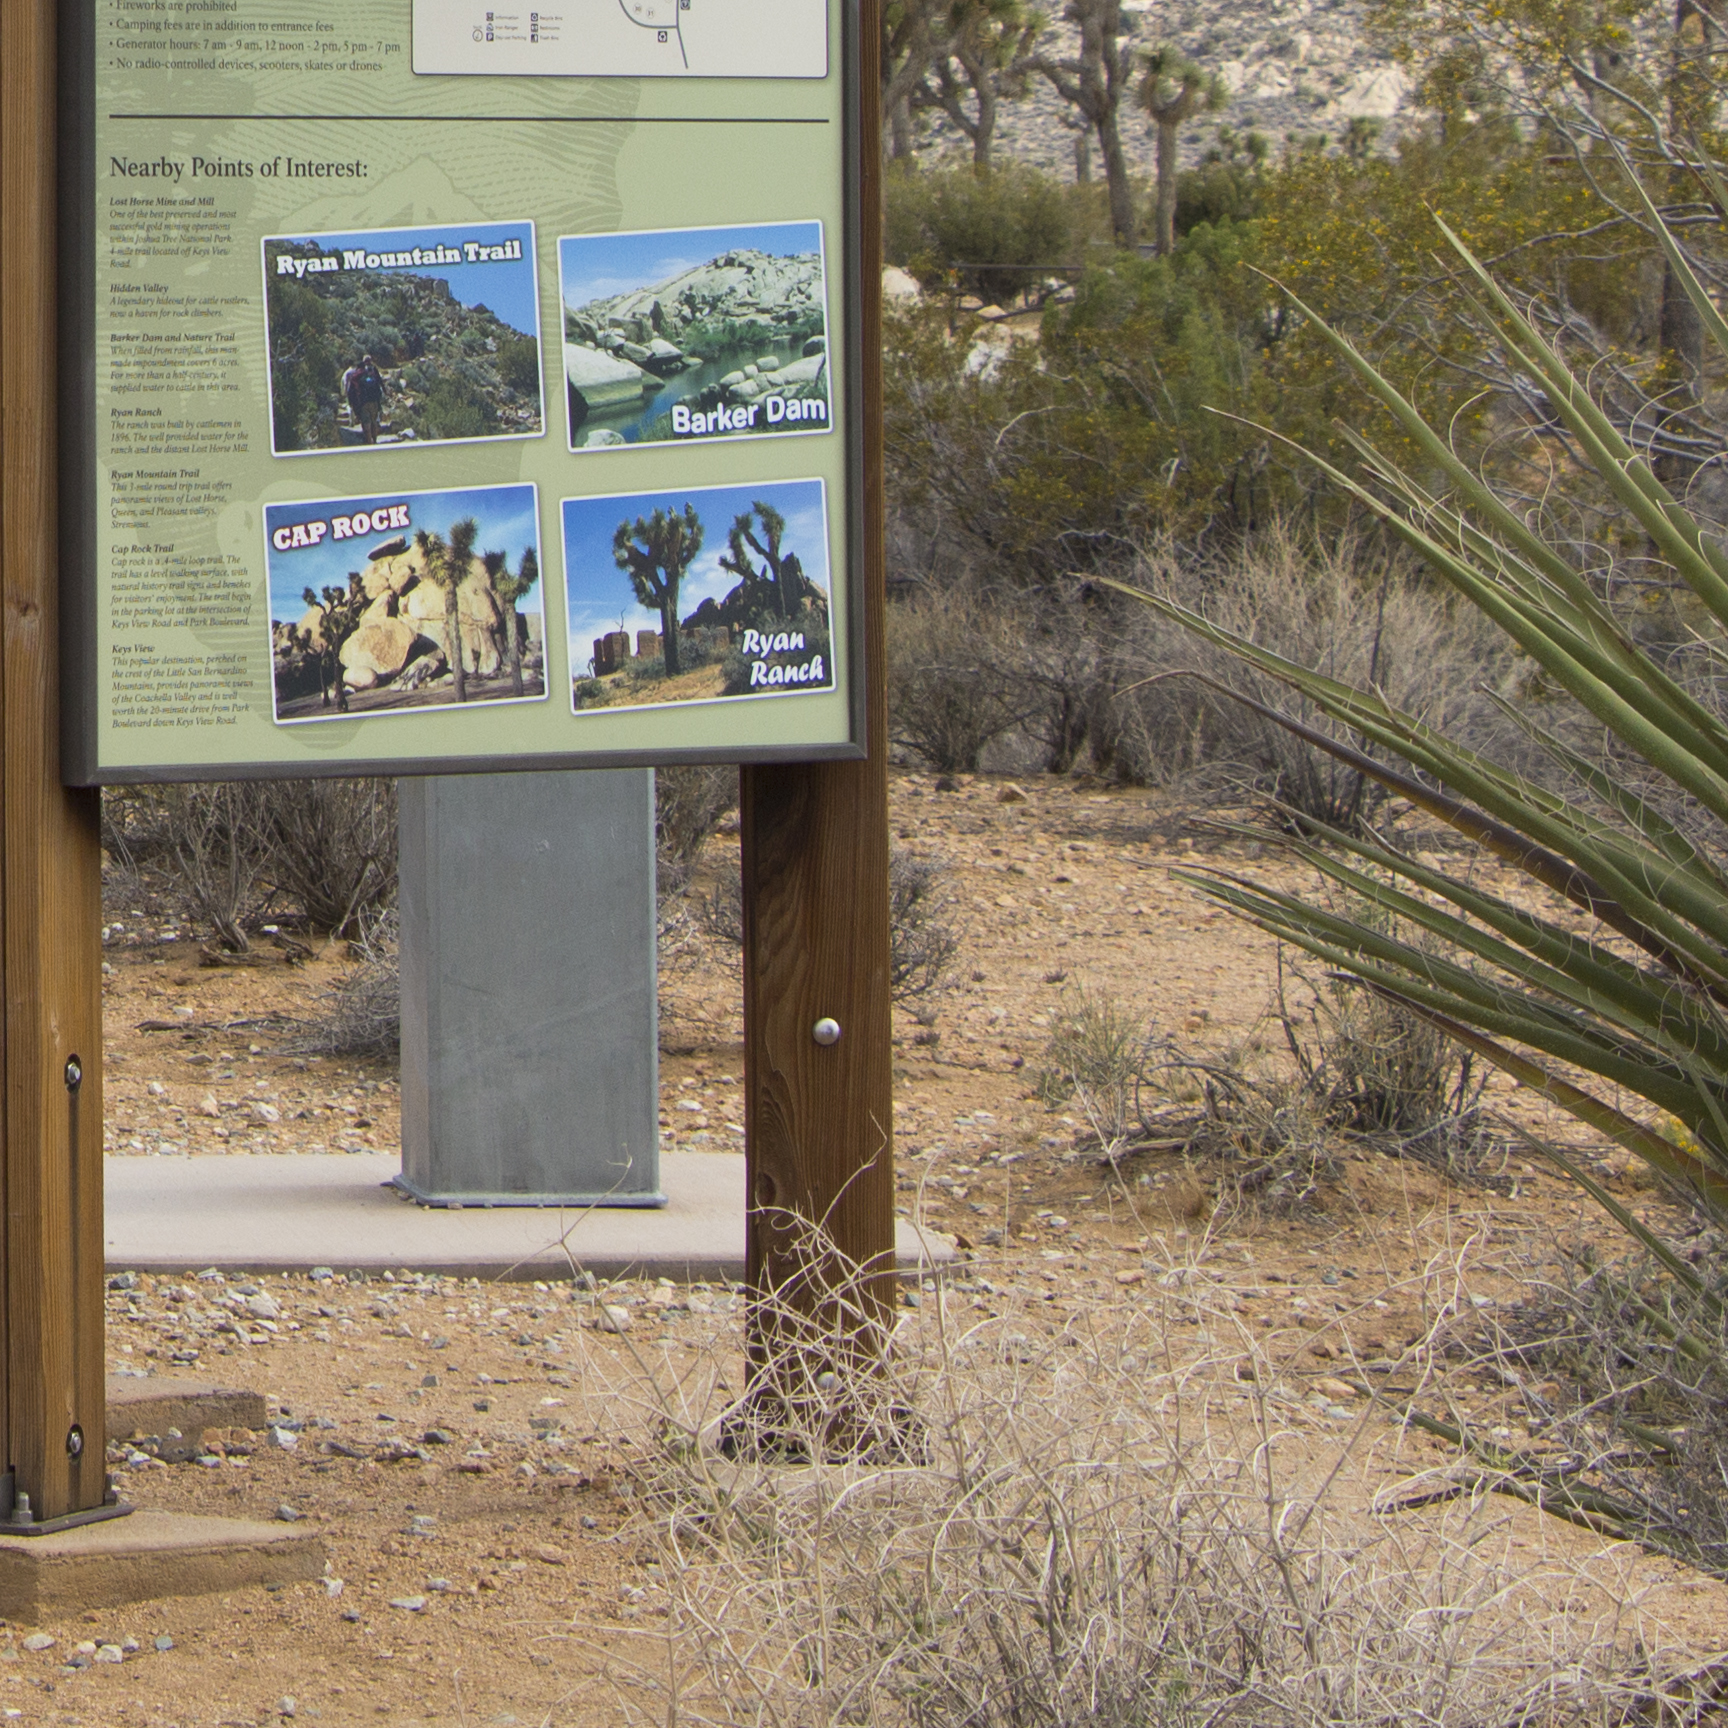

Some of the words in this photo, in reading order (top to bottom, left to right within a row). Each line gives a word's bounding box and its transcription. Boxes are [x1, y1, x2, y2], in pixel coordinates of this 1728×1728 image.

[116, 0, 166, 11] Fireworks
[168, 2, 183, 11] are
[185, 0, 237, 14] prohibited
[110, 155, 184, 183] Nearby
[192, 156, 253, 177] Points
[259, 155, 281, 177] of
[286, 157, 367, 177] Interest:
[109, 196, 127, 206] Lost
[129, 197, 154, 206] Horse
[155, 196, 177, 206] Mine
[178, 197, 196, 205] and
[198, 196, 214, 206] Mill
[276, 254, 338, 278] Ryan
[342, 245, 461, 271] Mountain
[464, 239, 522, 262] Trail
[109, 283, 140, 292] Hidden
[143, 283, 168, 294] Valley
[110, 333, 140, 342] Barker
[141, 333, 162, 342] Dam
[164, 332, 181, 342] and
[184, 333, 212, 342] Nature
[215, 332, 235, 341] Trail
[110, 408, 133, 417] Ryan
[134, 407, 162, 417] Ranch
[671, 403, 760, 435] Barker
[766, 395, 827, 424] Dam
[111, 470, 133, 479] Ryan
[136, 469, 177, 478] Mountain
[179, 468, 199, 478] Trail
[272, 518, 327, 551] CAP
[332, 505, 411, 540] ROCK
[111, 544, 129, 555] Cap
[131, 543, 152, 553] Rock
[153, 543, 174, 553] Trail
[112, 644, 131, 655] Keys
[134, 643, 155, 653] View
[742, 629, 806, 657] Ryan
[750, 655, 824, 687] Ranch
